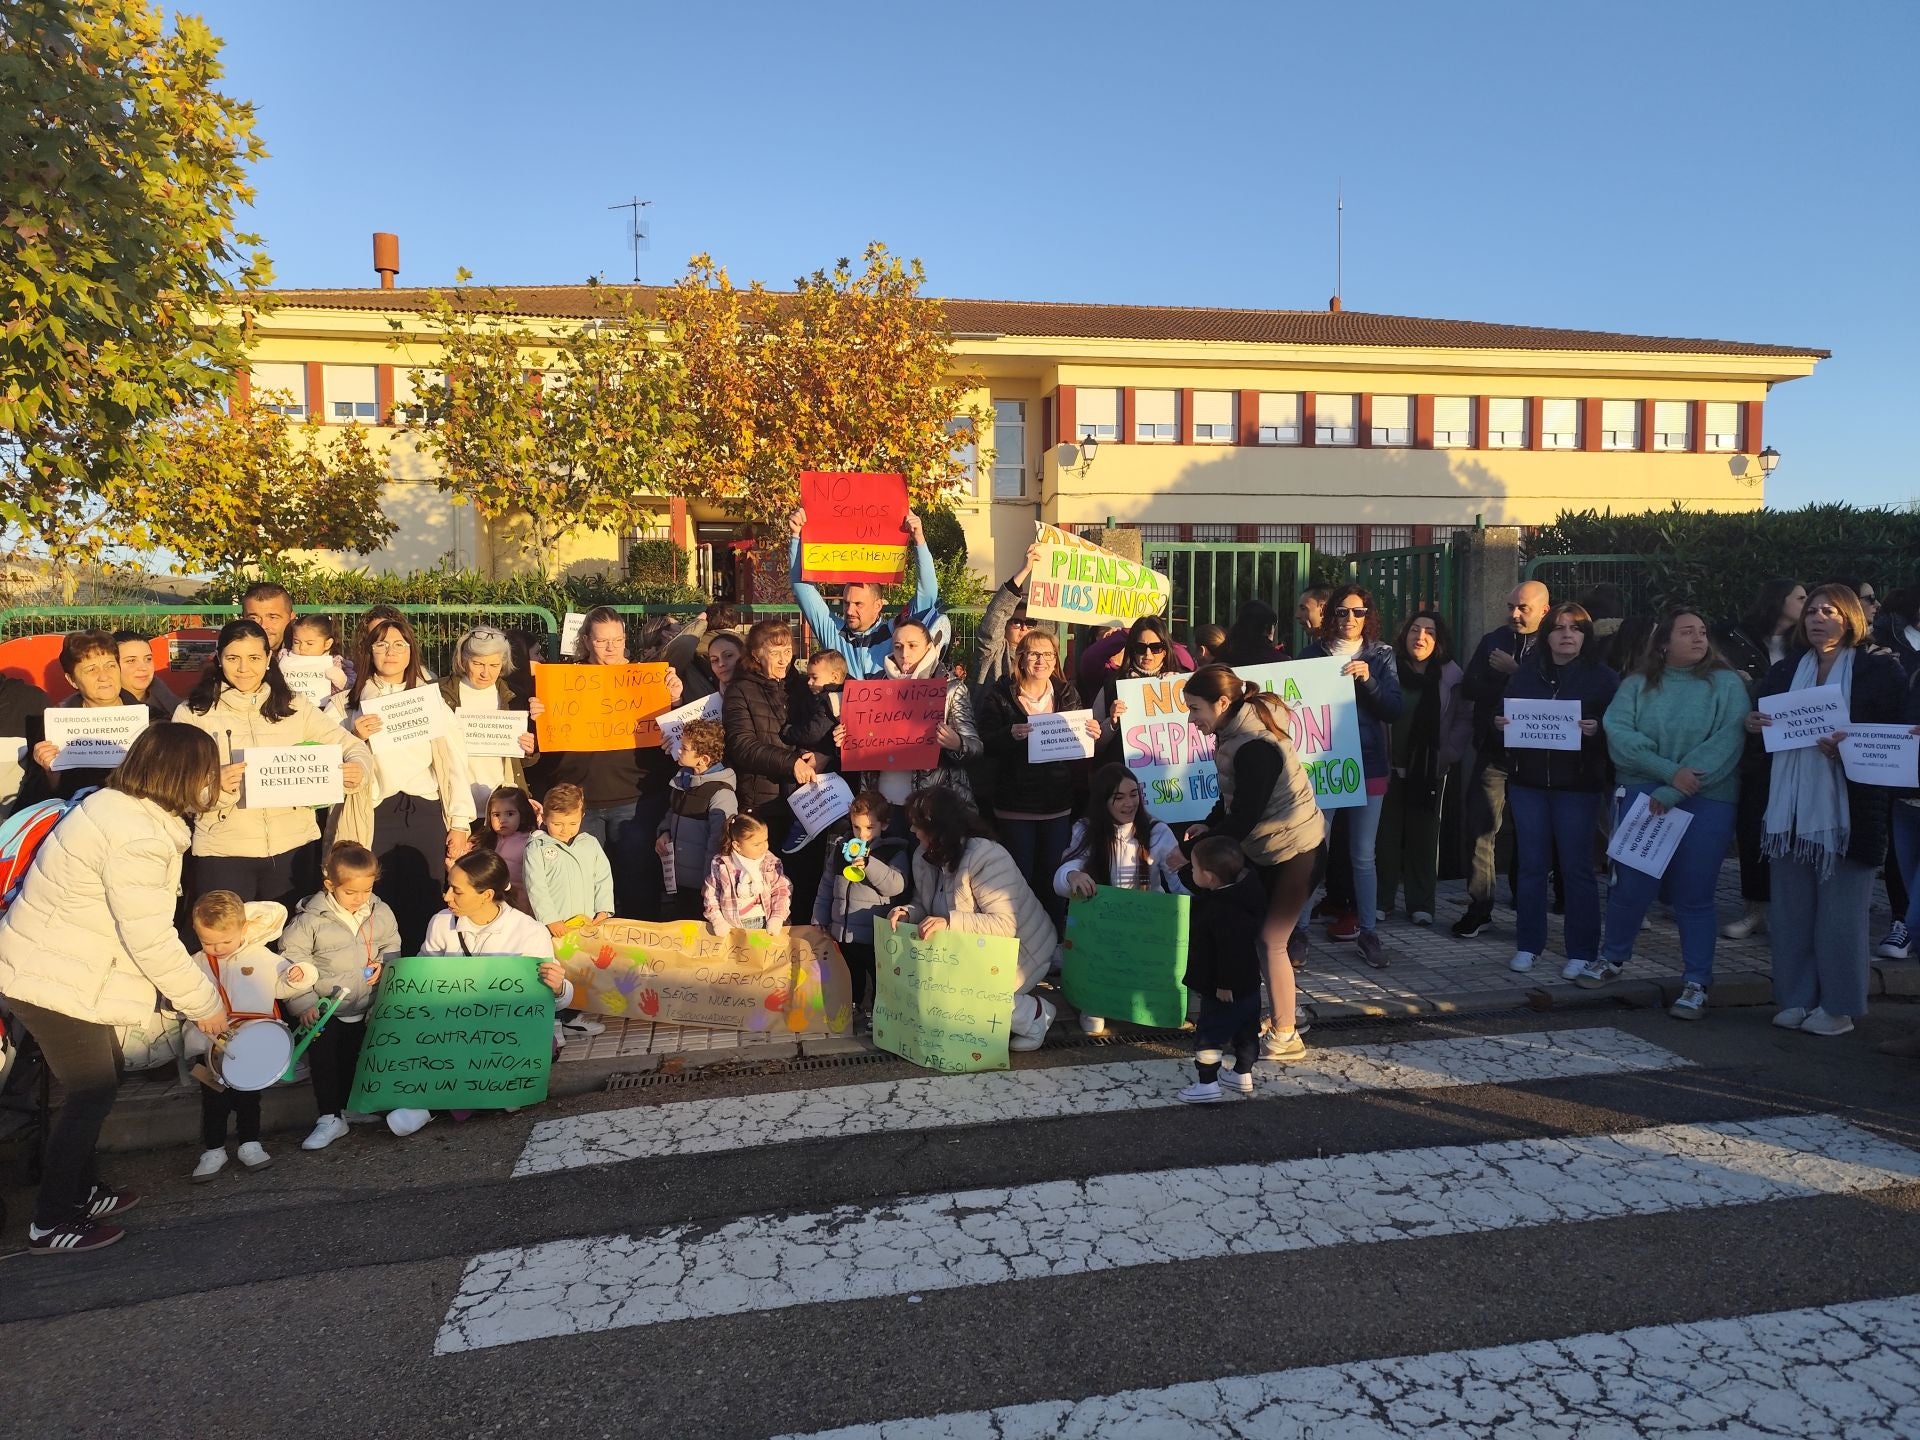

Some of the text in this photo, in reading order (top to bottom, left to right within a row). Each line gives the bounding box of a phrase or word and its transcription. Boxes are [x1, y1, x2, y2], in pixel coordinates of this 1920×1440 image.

[813, 477, 850, 501] NO
[832, 504, 890, 518] SOMOS
[856, 522, 880, 538] UN
[807, 546, 905, 563] EXPERIMENTO
[1052, 548, 1158, 590] PIENSA
[1030, 581, 1059, 608] EN
[1061, 584, 1093, 612] LOS
[564, 670, 662, 691] LOS NIÑOS
[846, 685, 947, 703] LOS NIÑOS
[552, 696, 643, 718] NO SON
[703, 709, 718, 719] SER
[1789, 702, 1838, 716] NIÑOS/AS
[386, 716, 429, 733] SUSPENSO
[1531, 712, 1575, 722] NIÑOS/AS
[1787, 715, 1825, 728] NO SON
[1050, 726, 1080, 735] QUEREMOS
[1520, 732, 1567, 740] JUGUETES
[1783, 725, 1836, 740] JUGUETES
[1870, 732, 1913, 740] EXTREMADURA
[842, 734, 936, 751] ESCUCHADLOS
[273, 753, 316, 763] AÚN NO
[260, 765, 329, 776] QUIERO SER
[261, 776, 329, 787] RESILIENTE
[1152, 777, 1183, 804] SUS
[1630, 842, 1638, 852] NO
[1640, 839, 1655, 858] SEÑOS
[700, 939, 750, 963] REYES
[383, 966, 524, 996] PARALIZAR LOS
[641, 958, 788, 989] NO QUEREMOS
[662, 986, 757, 1008] SEÑOS NUEVAS
[445, 1003, 545, 1019] MODIFICAR
[367, 1029, 521, 1050] LOS CONTRATOS,
[364, 1052, 542, 1073] NUESTROS NIÑO/AS
[361, 1076, 540, 1094] NO SON UN JUGUETE
